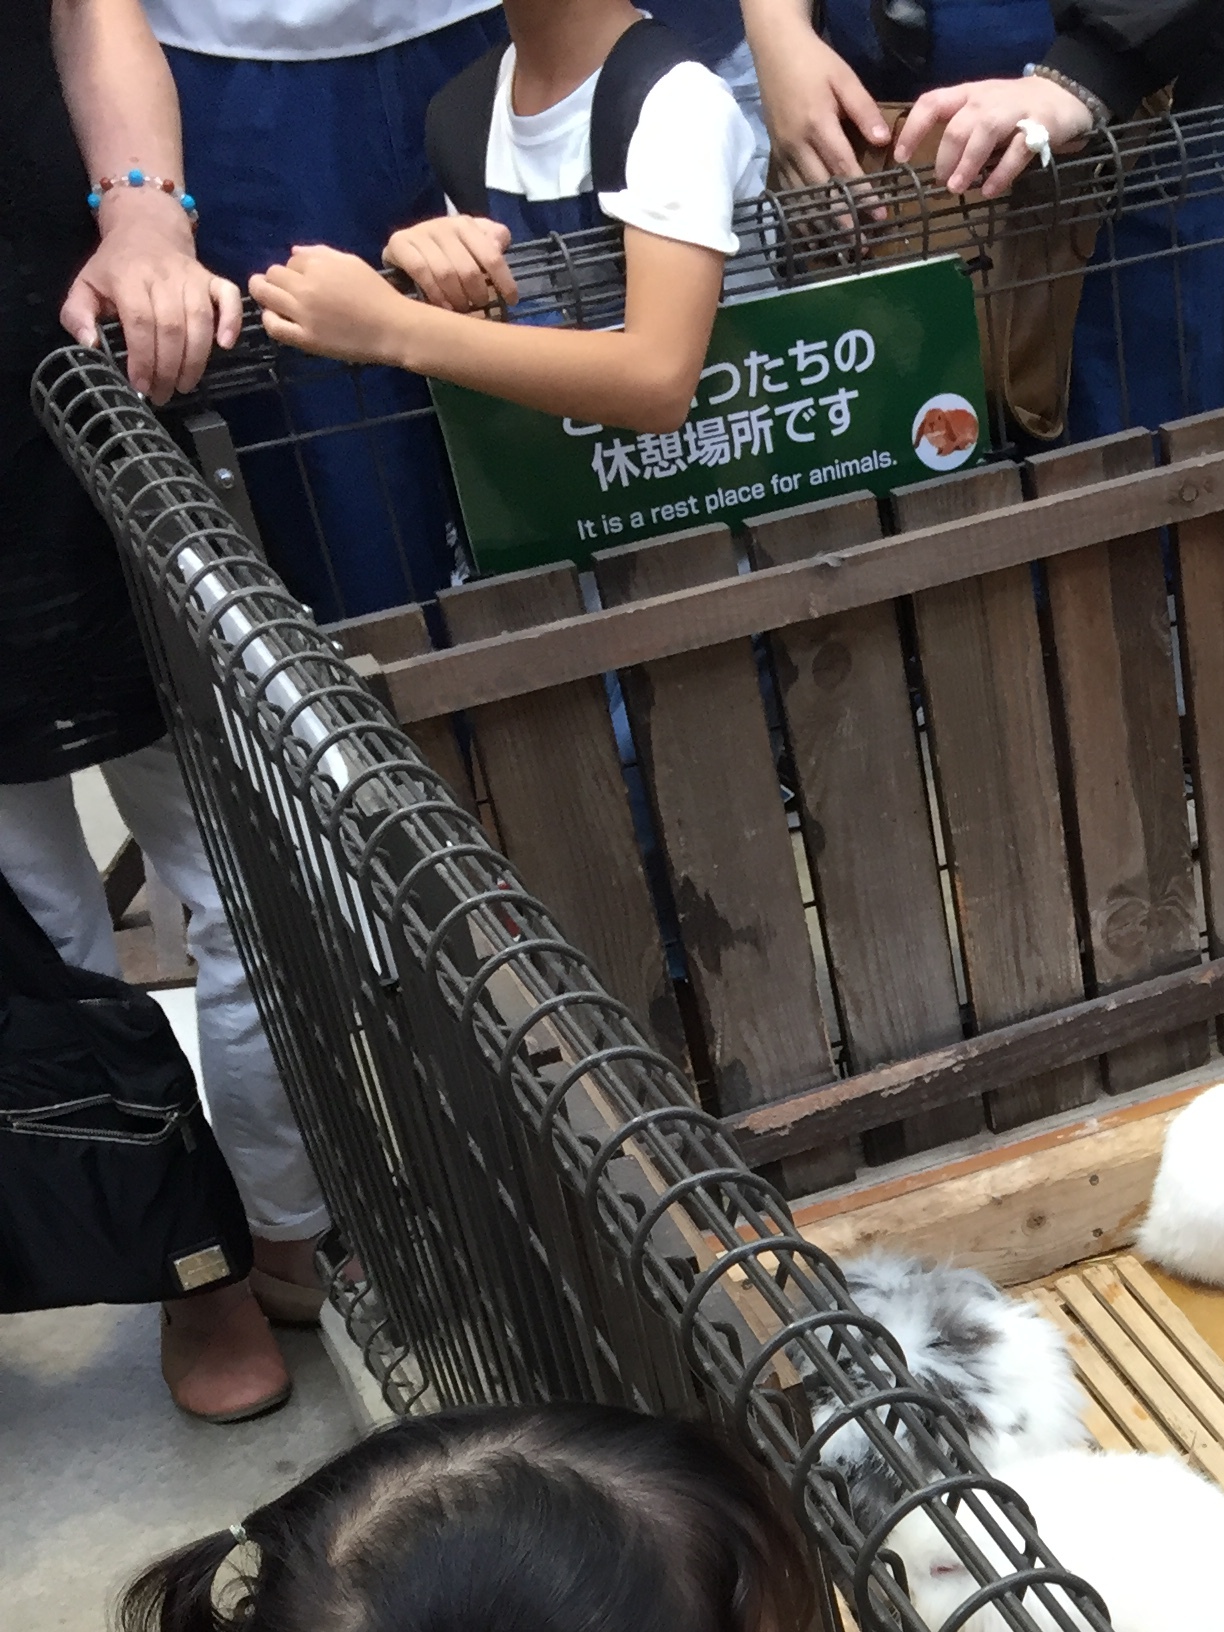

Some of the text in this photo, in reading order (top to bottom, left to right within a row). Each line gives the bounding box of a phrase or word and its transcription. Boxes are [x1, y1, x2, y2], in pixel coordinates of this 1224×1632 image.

[591, 387, 859, 492] 休憩場所です
[577, 450, 898, 540] It is a rest place for animals.
